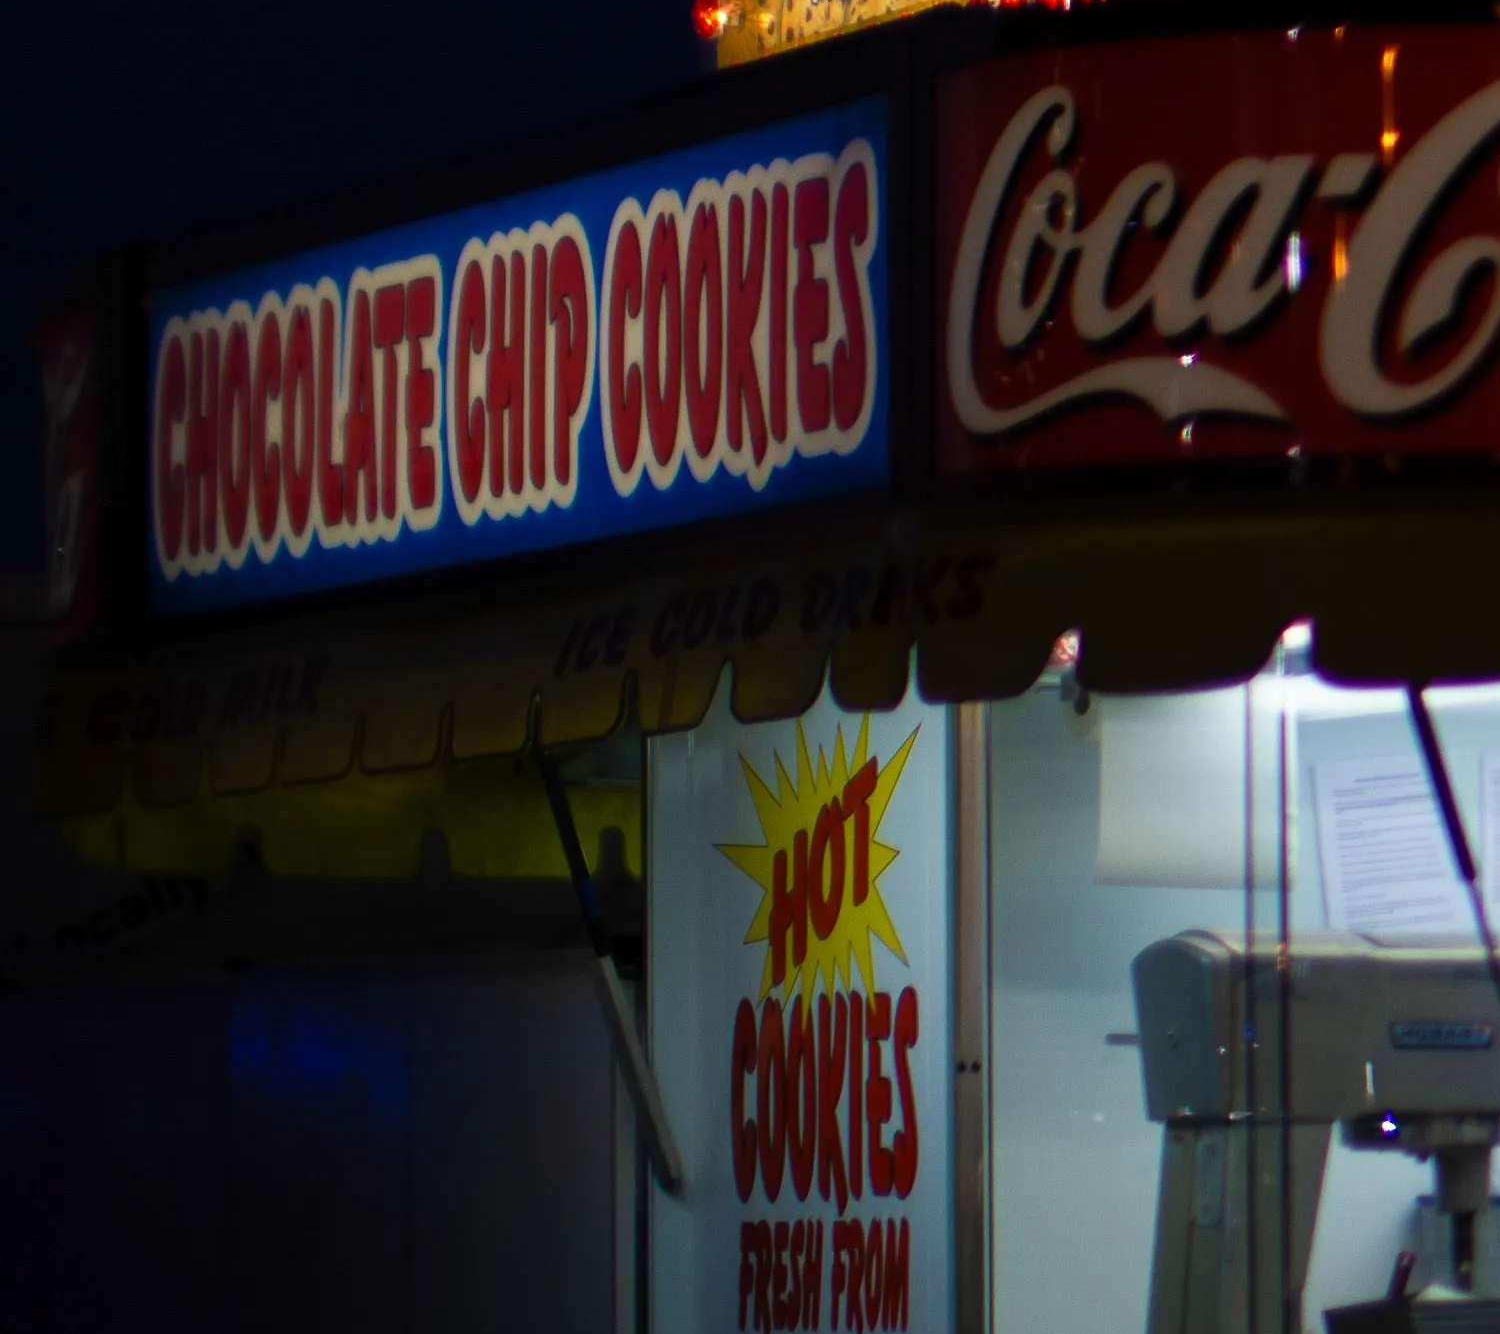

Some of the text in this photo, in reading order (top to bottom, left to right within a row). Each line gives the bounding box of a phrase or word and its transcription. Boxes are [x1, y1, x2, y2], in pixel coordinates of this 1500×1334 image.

[150, 253, 443, 581] CHOCOLATE
[445, 212, 596, 525] CHIP
[599, 136, 878, 497] COOKIES
[555, 605, 638, 679] ICE
[650, 575, 781, 659] COLD
[771, 756, 880, 986] HOT
[731, 986, 919, 1214] COOKIES
[831, 1217, 908, 1333] FROM
